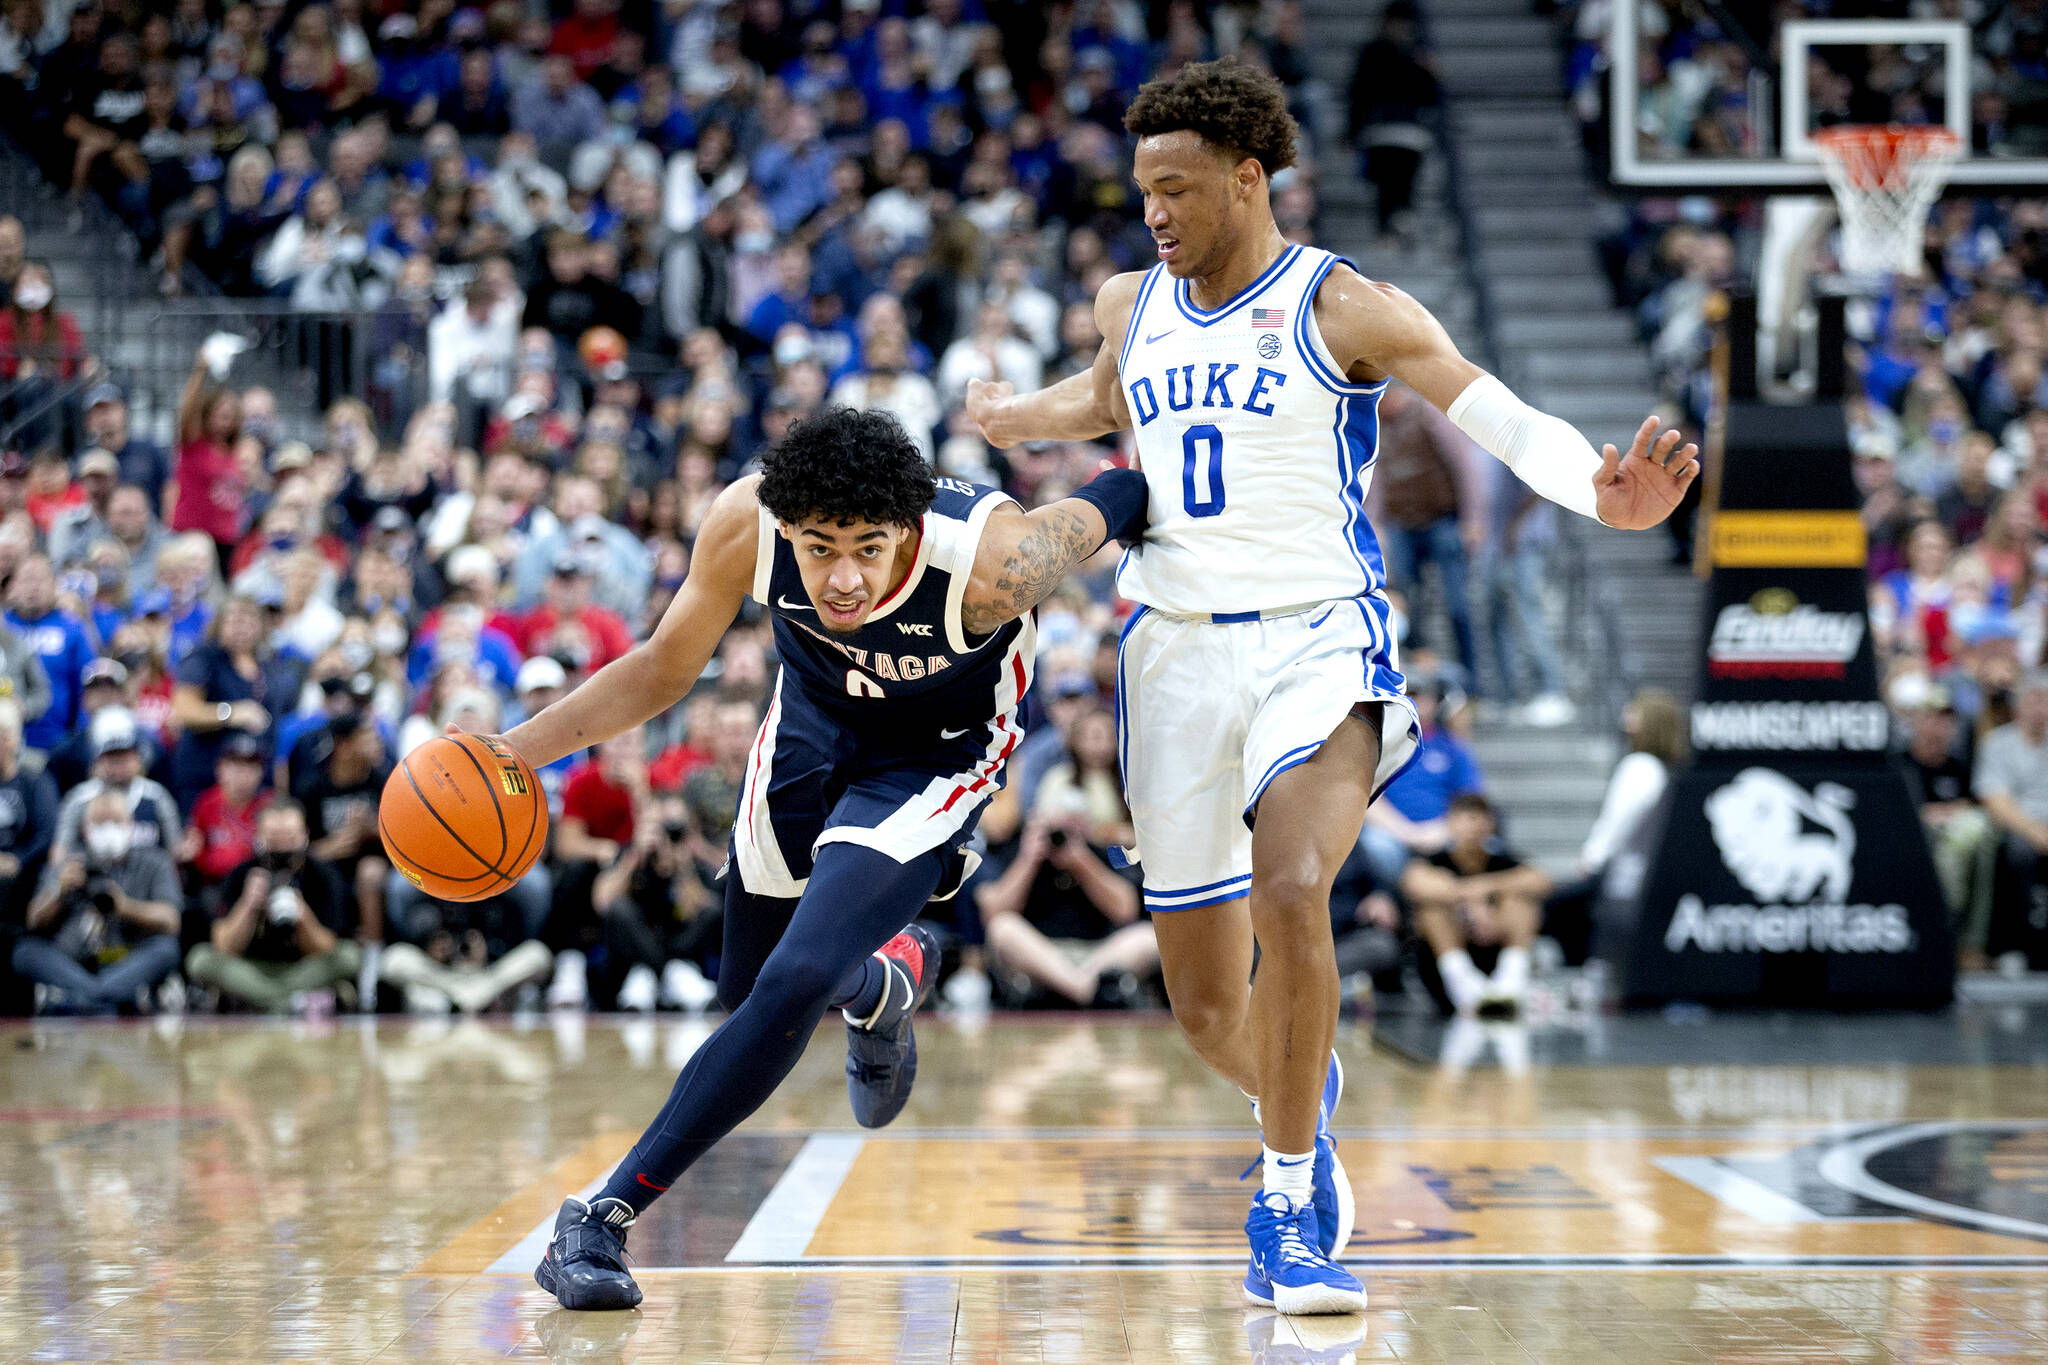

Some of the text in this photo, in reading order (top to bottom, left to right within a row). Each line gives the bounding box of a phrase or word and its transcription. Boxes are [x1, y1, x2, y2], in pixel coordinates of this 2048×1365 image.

[1130, 363, 1287, 427] DUKE
[1182, 424, 1226, 518] 0
[896, 622, 933, 637] WCC
[1691, 702, 1889, 750] MANSCAPED
[1665, 893, 1911, 953] Ameritas
